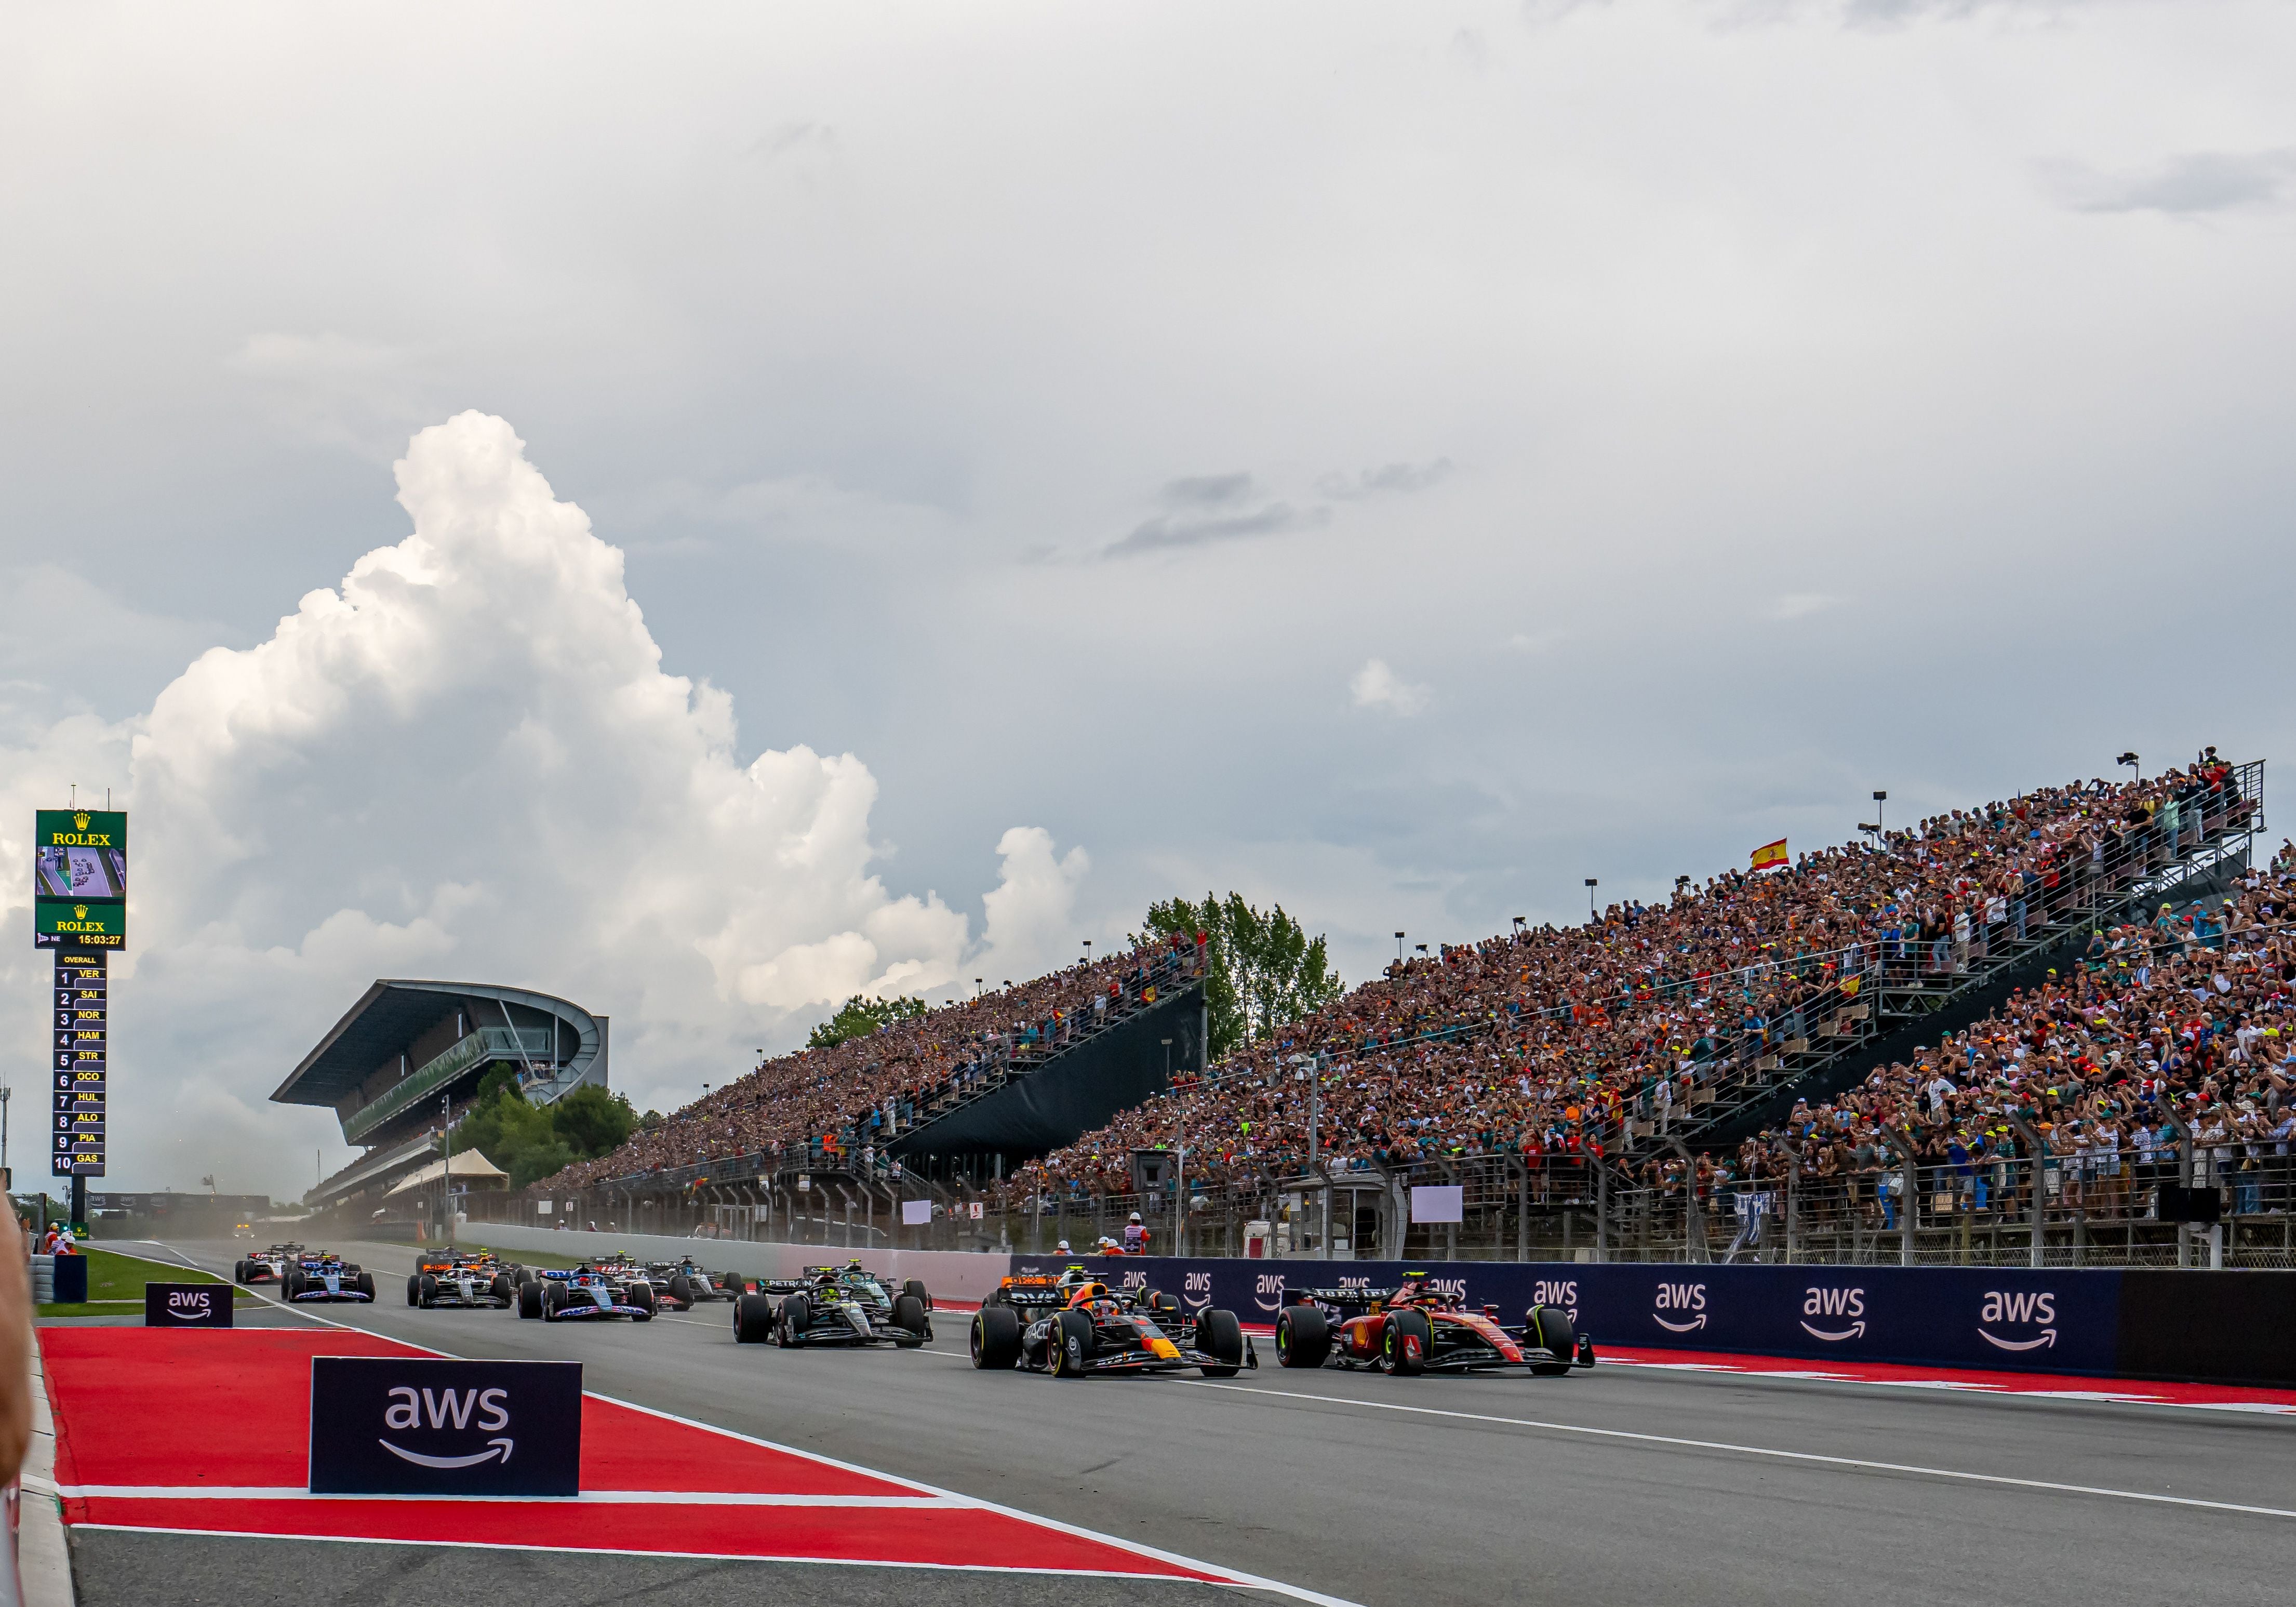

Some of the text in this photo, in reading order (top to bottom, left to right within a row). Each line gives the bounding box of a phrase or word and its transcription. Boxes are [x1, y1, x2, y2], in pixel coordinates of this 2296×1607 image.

[53, 833, 111, 846] ROLEX
[57, 921, 104, 932] ROLEX
[79, 935, 121, 945] 15:03:27
[62, 969, 99, 984] 1 VER
[61, 993, 69, 1005] 2
[60, 1011, 99, 1025] 3 NOR
[60, 1031, 99, 1045] 4 HAM
[60, 1052, 98, 1066] 5 STR
[60, 1072, 99, 1087] 6 OCO
[60, 1096, 68, 1107] 7
[59, 1117, 68, 1128] 8
[59, 1137, 67, 1148] 9
[56, 1154, 98, 1169] 10 GAS
[1124, 1271, 1147, 1288] aws
[1185, 1272, 1211, 1292] aws
[1256, 1274, 1285, 1294] aws
[169, 1292, 210, 1307] aws
[1534, 1281, 1578, 1306] aws
[1656, 1283, 1706, 1310] aws
[1804, 1287, 1864, 1317] aws
[1982, 1291, 2055, 1324] aws
[385, 1386, 509, 1431] aws
